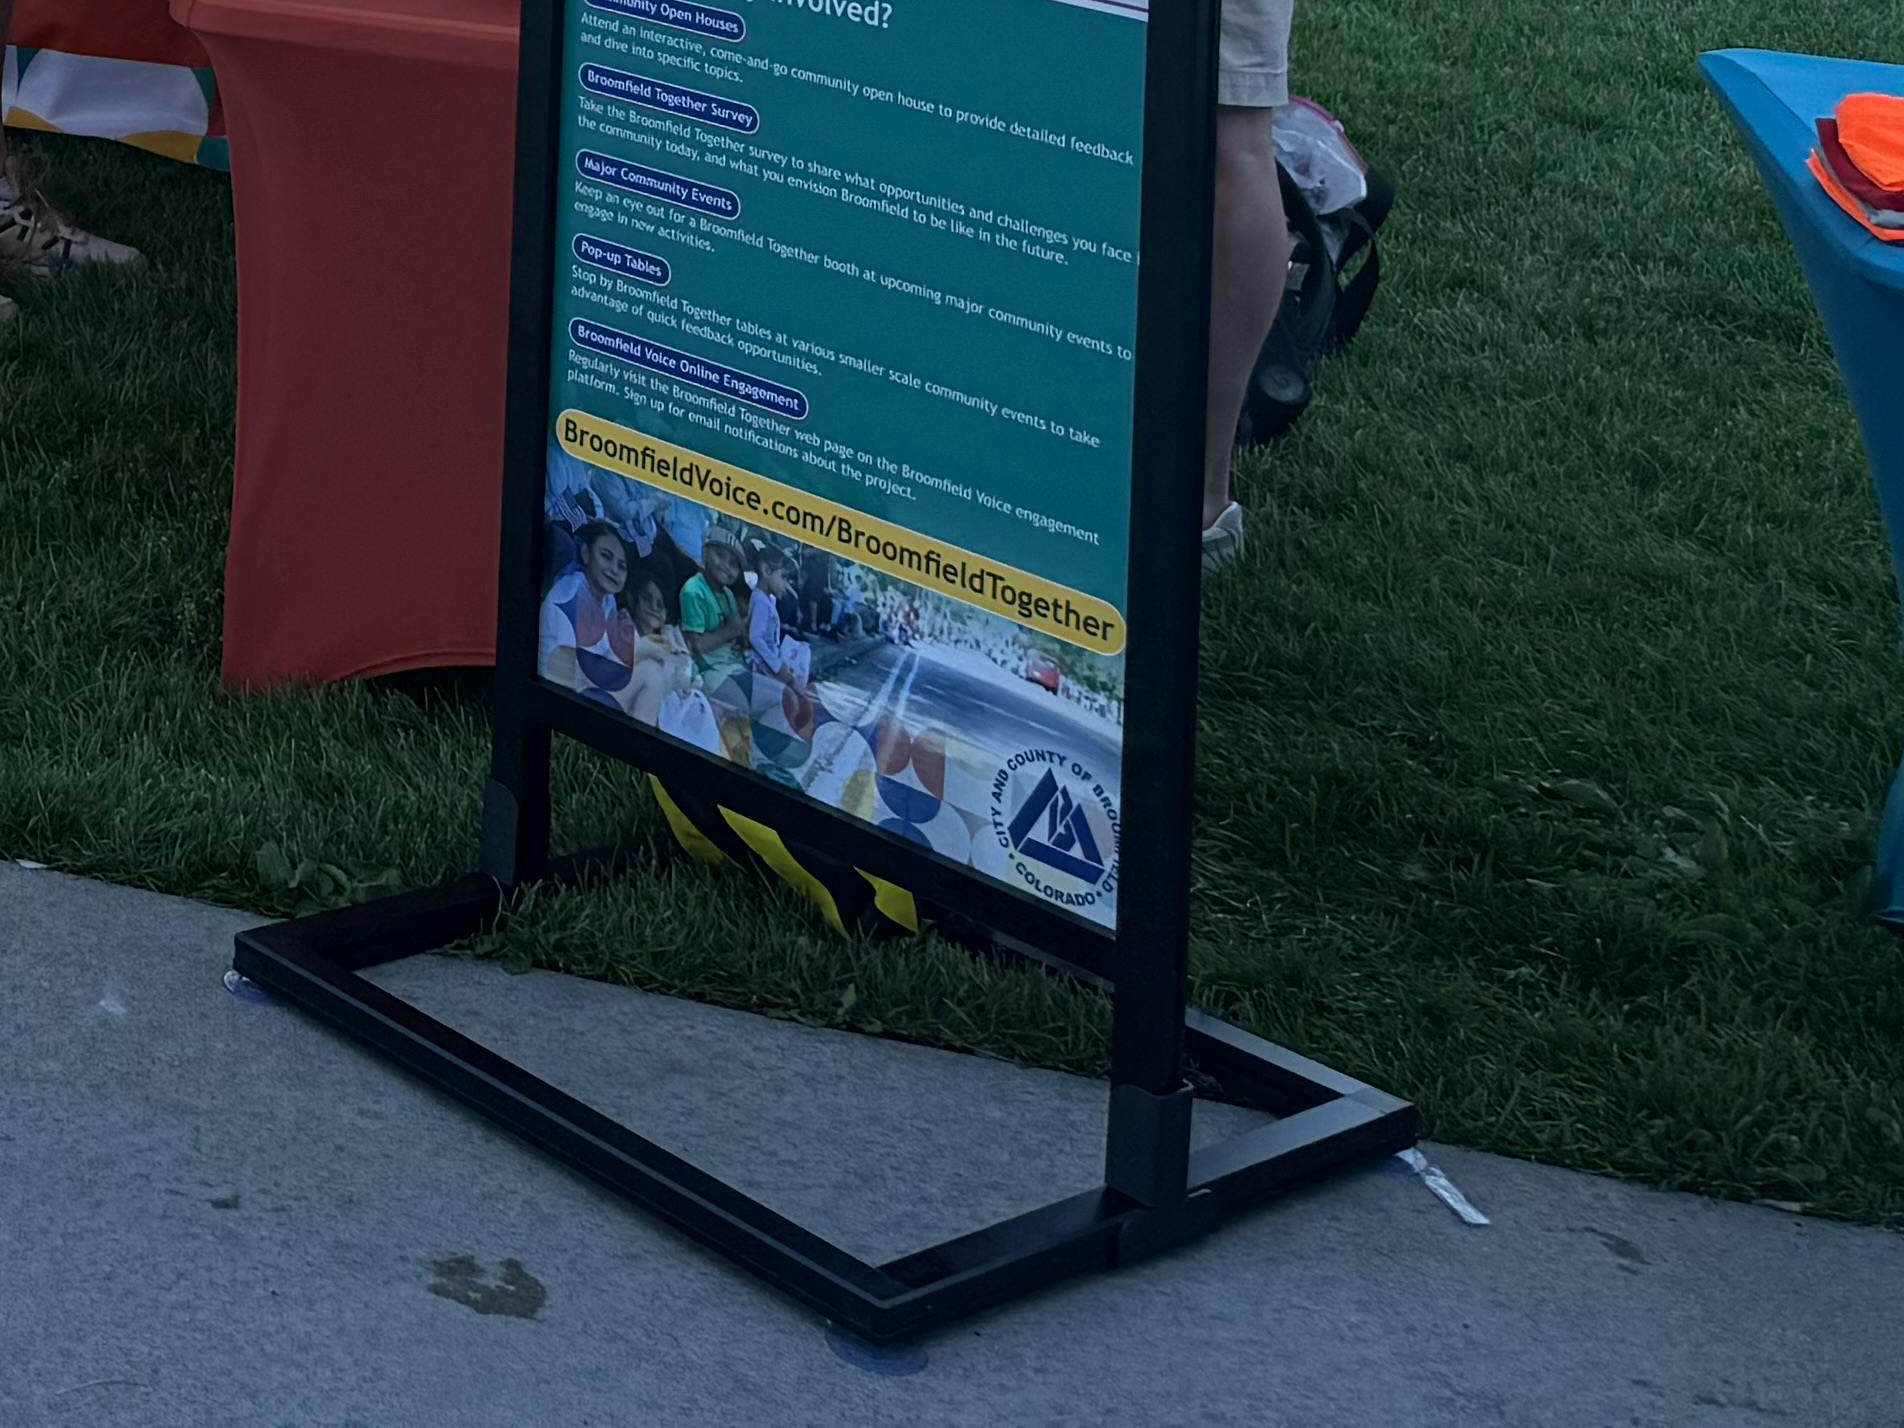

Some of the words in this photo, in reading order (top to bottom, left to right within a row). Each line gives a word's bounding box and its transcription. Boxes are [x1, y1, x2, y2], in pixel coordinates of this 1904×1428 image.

[660, 2, 691, 21] Open
[695, 11, 738, 33] Houses
[587, 69, 651, 97] Broomfield
[654, 87, 707, 112] Together
[711, 102, 752, 127] Survey
[584, 157, 617, 175] Major
[620, 167, 688, 200] Community
[691, 187, 732, 210] Events
[581, 240, 621, 265] Pop-up
[624, 253, 661, 276] Tables
[577, 324, 641, 356] Broomfield
[644, 346, 676, 368] Voice
[679, 359, 720, 383] Online
[723, 373, 798, 410] Engagement
[564, 419, 1115, 642] BroomfieldVoice.com/BroomfieldTogether
[1016, 862, 1096, 906] COLORADO
